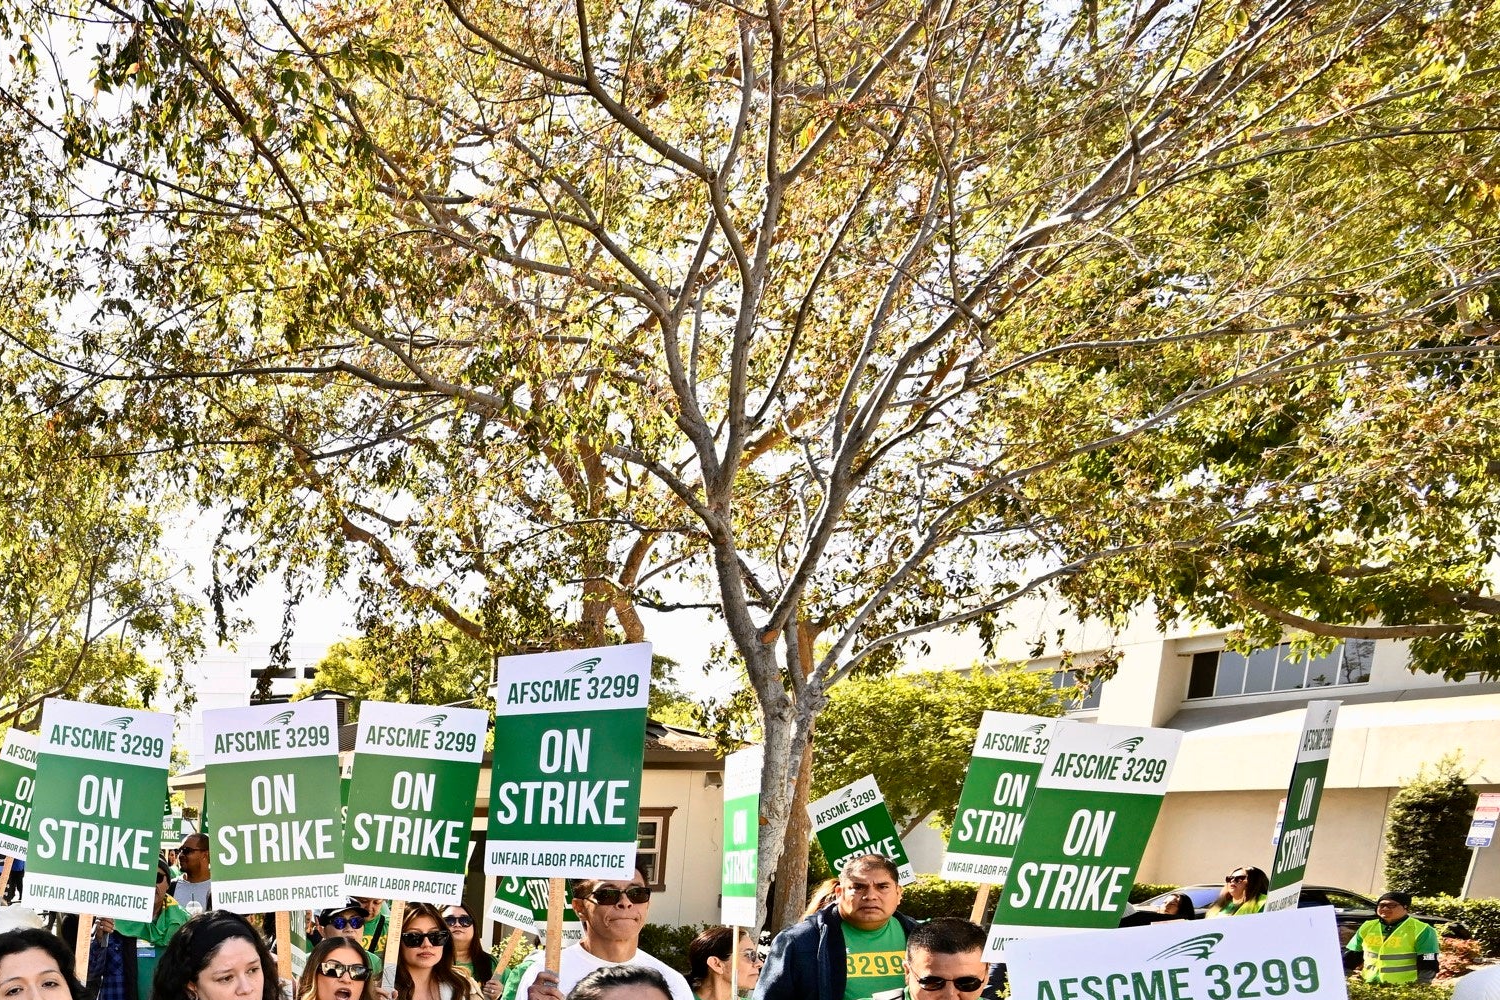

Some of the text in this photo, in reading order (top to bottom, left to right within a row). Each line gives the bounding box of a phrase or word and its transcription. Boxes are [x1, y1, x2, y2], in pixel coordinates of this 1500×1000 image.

[507, 674, 639, 705] AFSCME 3299
[7, 743, 37, 764] AFSCM
[50, 724, 164, 759] AFSCME 3299
[214, 725, 330, 754] AFSCME 3299
[366, 725, 476, 753] AFSCME 3299
[539, 729, 590, 773] ON
[983, 733, 1049, 755] AFSCME 32
[1051, 753, 1167, 784] AFSCME 3299
[78, 774, 123, 819] ON
[251, 774, 296, 815] ON
[392, 771, 436, 811] ON
[497, 780, 629, 825] STRIKE
[816, 789, 877, 826] AFSCME 3299
[994, 773, 1030, 807] ON
[1298, 777, 1317, 821] ON
[37, 817, 153, 871] STRIKE
[217, 818, 335, 866] STRIKE
[351, 813, 465, 860] STRIKE
[841, 820, 871, 849] ON
[958, 809, 1025, 846] STRIK
[1063, 809, 1115, 857] ON
[0, 839, 18, 852] LABOR
[491, 852, 625, 868] UNFAIR LABOR PRACTICE
[1277, 824, 1314, 874] STRIKE
[724, 849, 756, 884] STRIKE
[947, 861, 972, 873] UNFAIR
[973, 864, 997, 875] LABOR
[29, 884, 148, 910] UNFAIR LABOR PRACTICE
[218, 885, 340, 905] UNFAIR LABOR PRACTICE
[344, 874, 457, 895] UNFAIR LABOR PRACTICE
[1009, 862, 1131, 911] STRIKE
[493, 906, 534, 926] UNFAIR LABOR
[1207, 956, 1319, 1000] 3299
